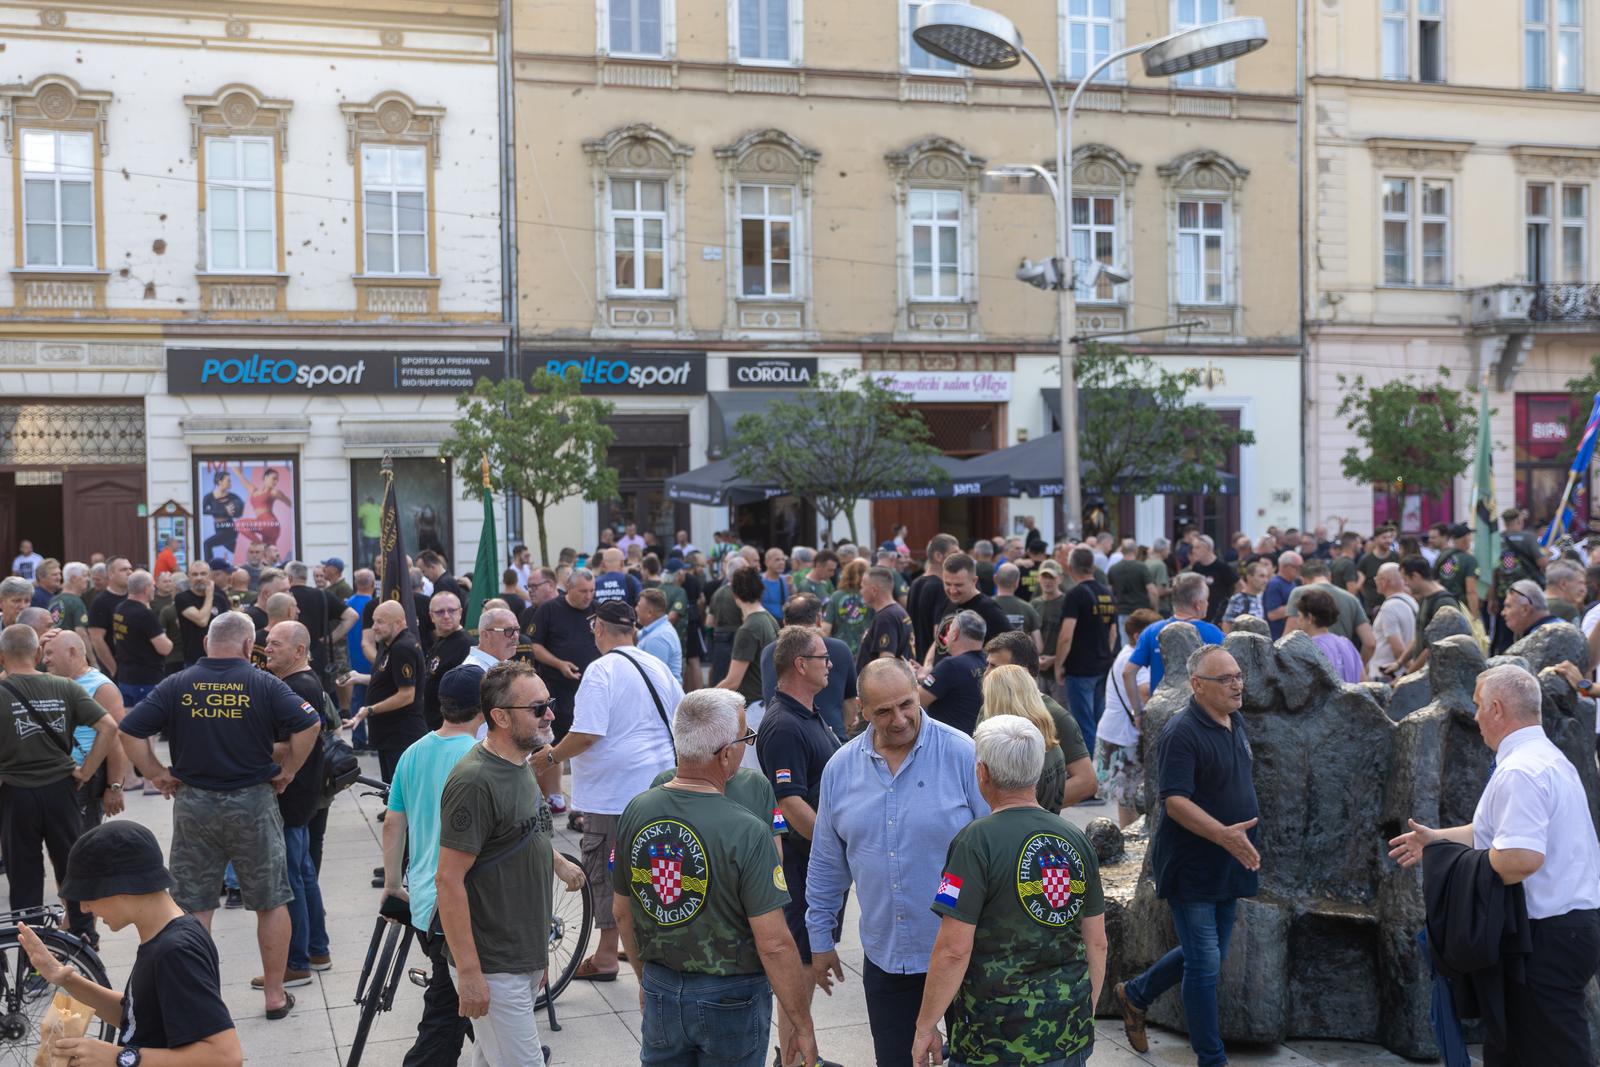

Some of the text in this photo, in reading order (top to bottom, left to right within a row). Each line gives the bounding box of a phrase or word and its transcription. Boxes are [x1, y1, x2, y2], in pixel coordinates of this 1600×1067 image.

[401, 357, 490, 365] SPORTSKA PREHRANA
[401, 368, 472, 376] FITNESS OPREMA
[737, 366, 810, 382] COROLLA
[1532, 421, 1567, 438] BIPA
[192, 682, 244, 691] VETERANI
[181, 693, 250, 708] 3. GBR
[191, 707, 243, 719] KUNE
[678, 827, 705, 875] VOJSKA
[1020, 836, 1052, 880] HRVATSKA
